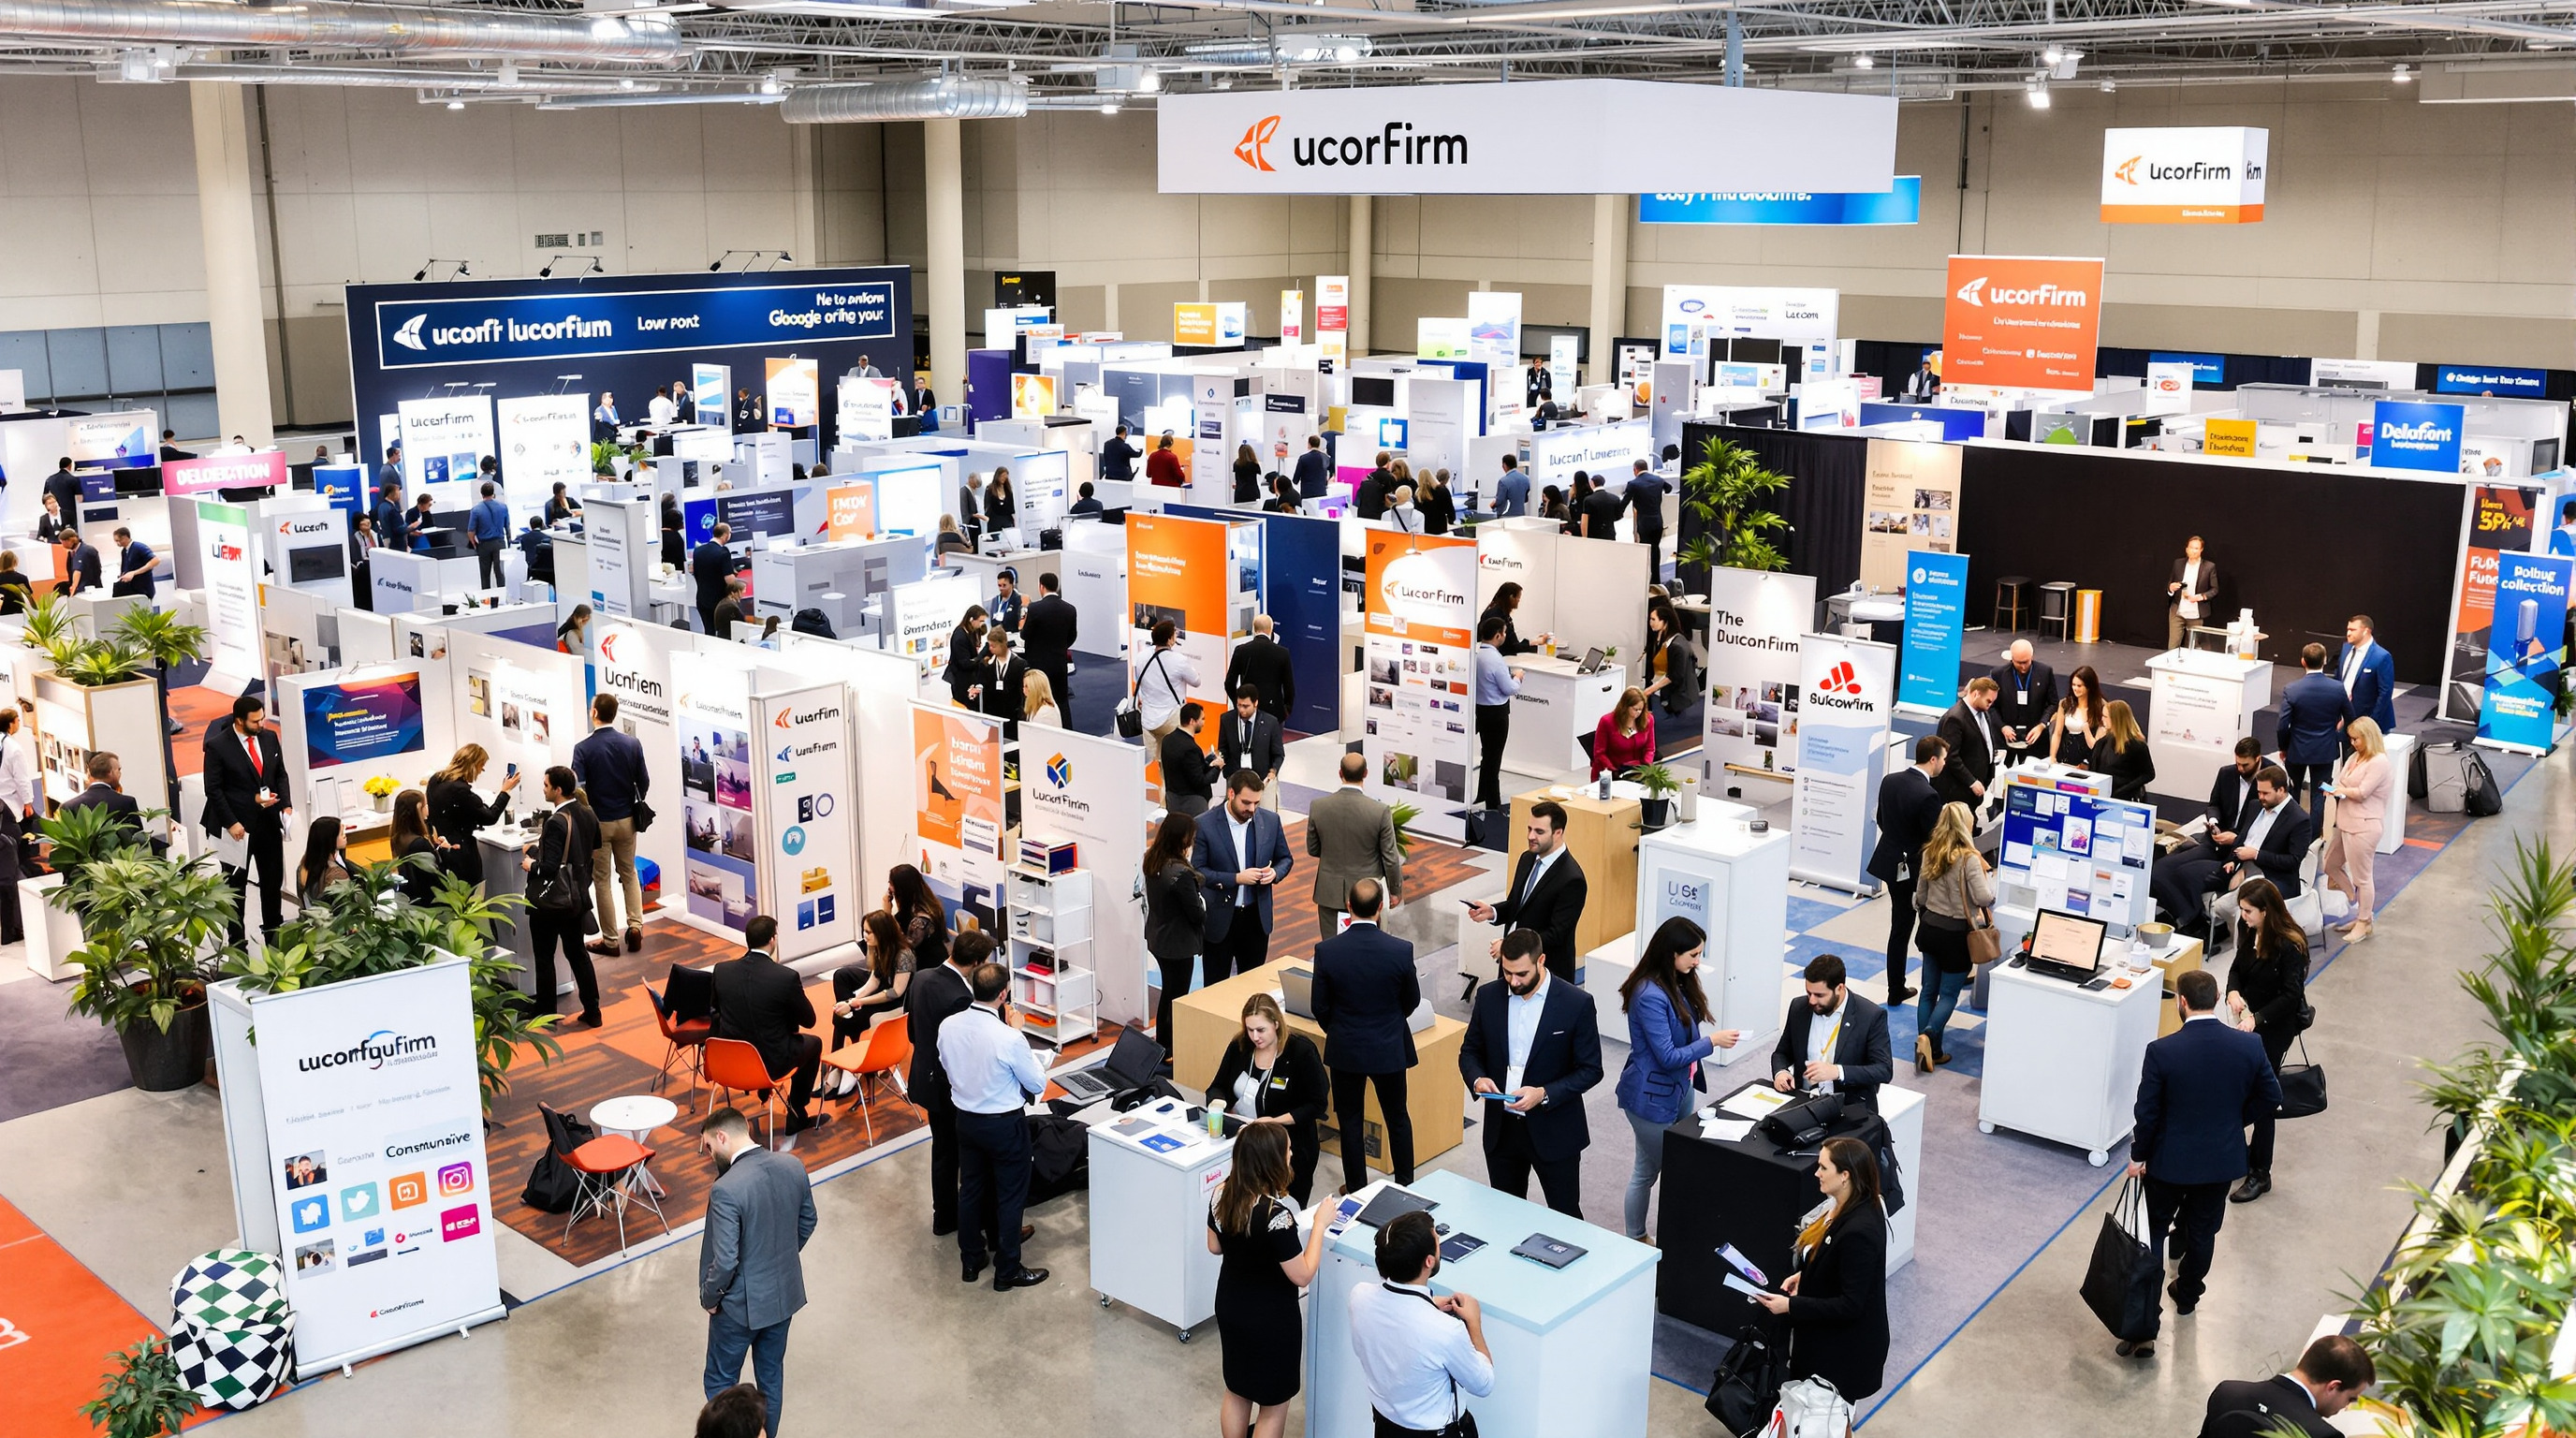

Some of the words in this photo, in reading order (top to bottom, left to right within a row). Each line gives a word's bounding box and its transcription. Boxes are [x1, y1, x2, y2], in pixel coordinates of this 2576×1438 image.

[1294, 122, 1468, 167] ucorFirm
[2150, 162, 2231, 180] ucorFirm
[1990, 284, 2086, 306] ucorFirm
[1717, 610, 1744, 626] The
